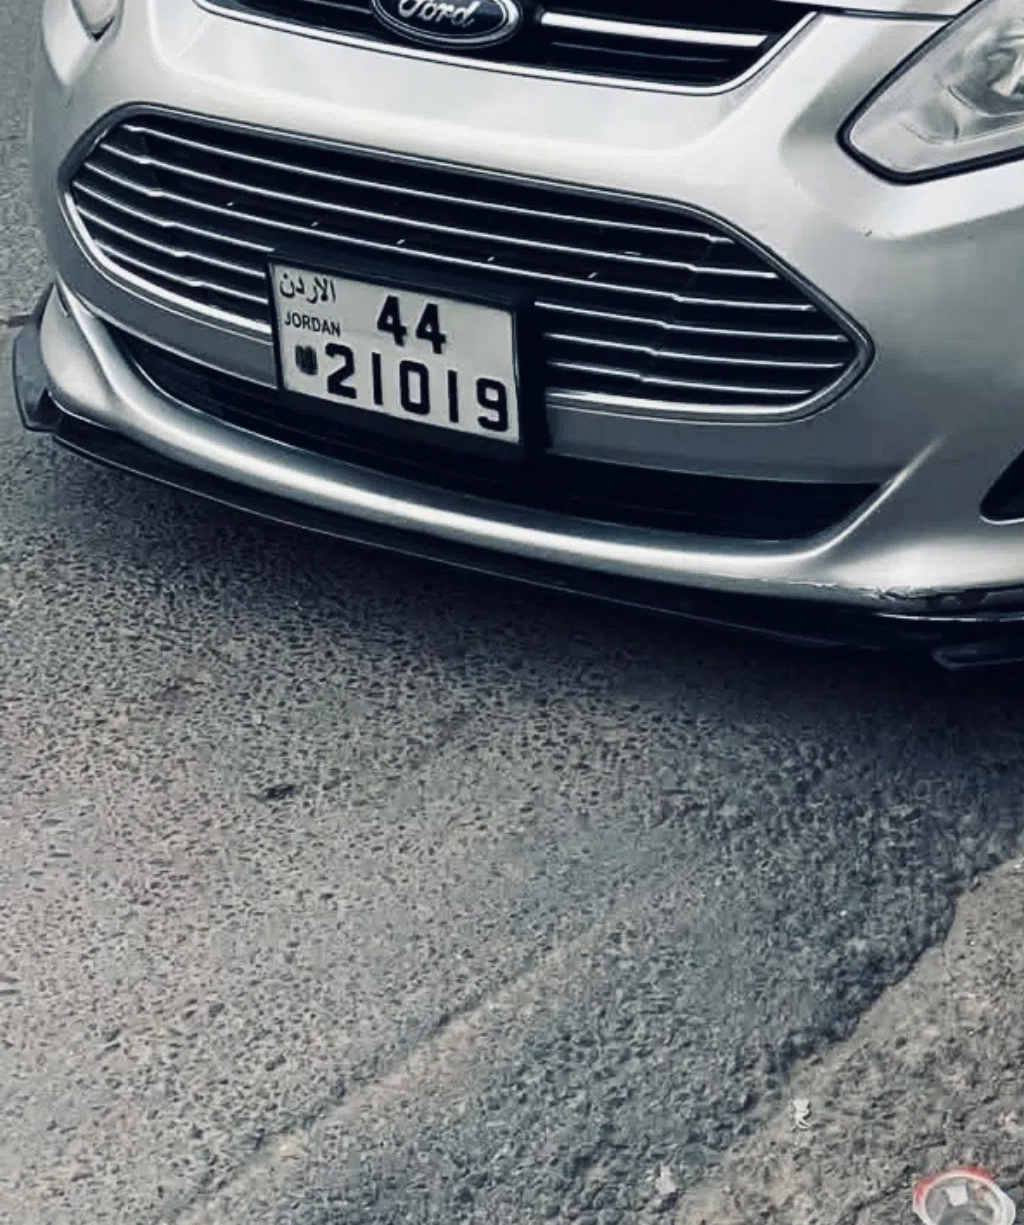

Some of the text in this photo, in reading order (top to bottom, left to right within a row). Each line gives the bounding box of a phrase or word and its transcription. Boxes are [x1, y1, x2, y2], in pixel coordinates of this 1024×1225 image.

[284, 311, 341, 338] JORDAN
[377, 295, 446, 354] 44
[325, 343, 509, 432] 21019
